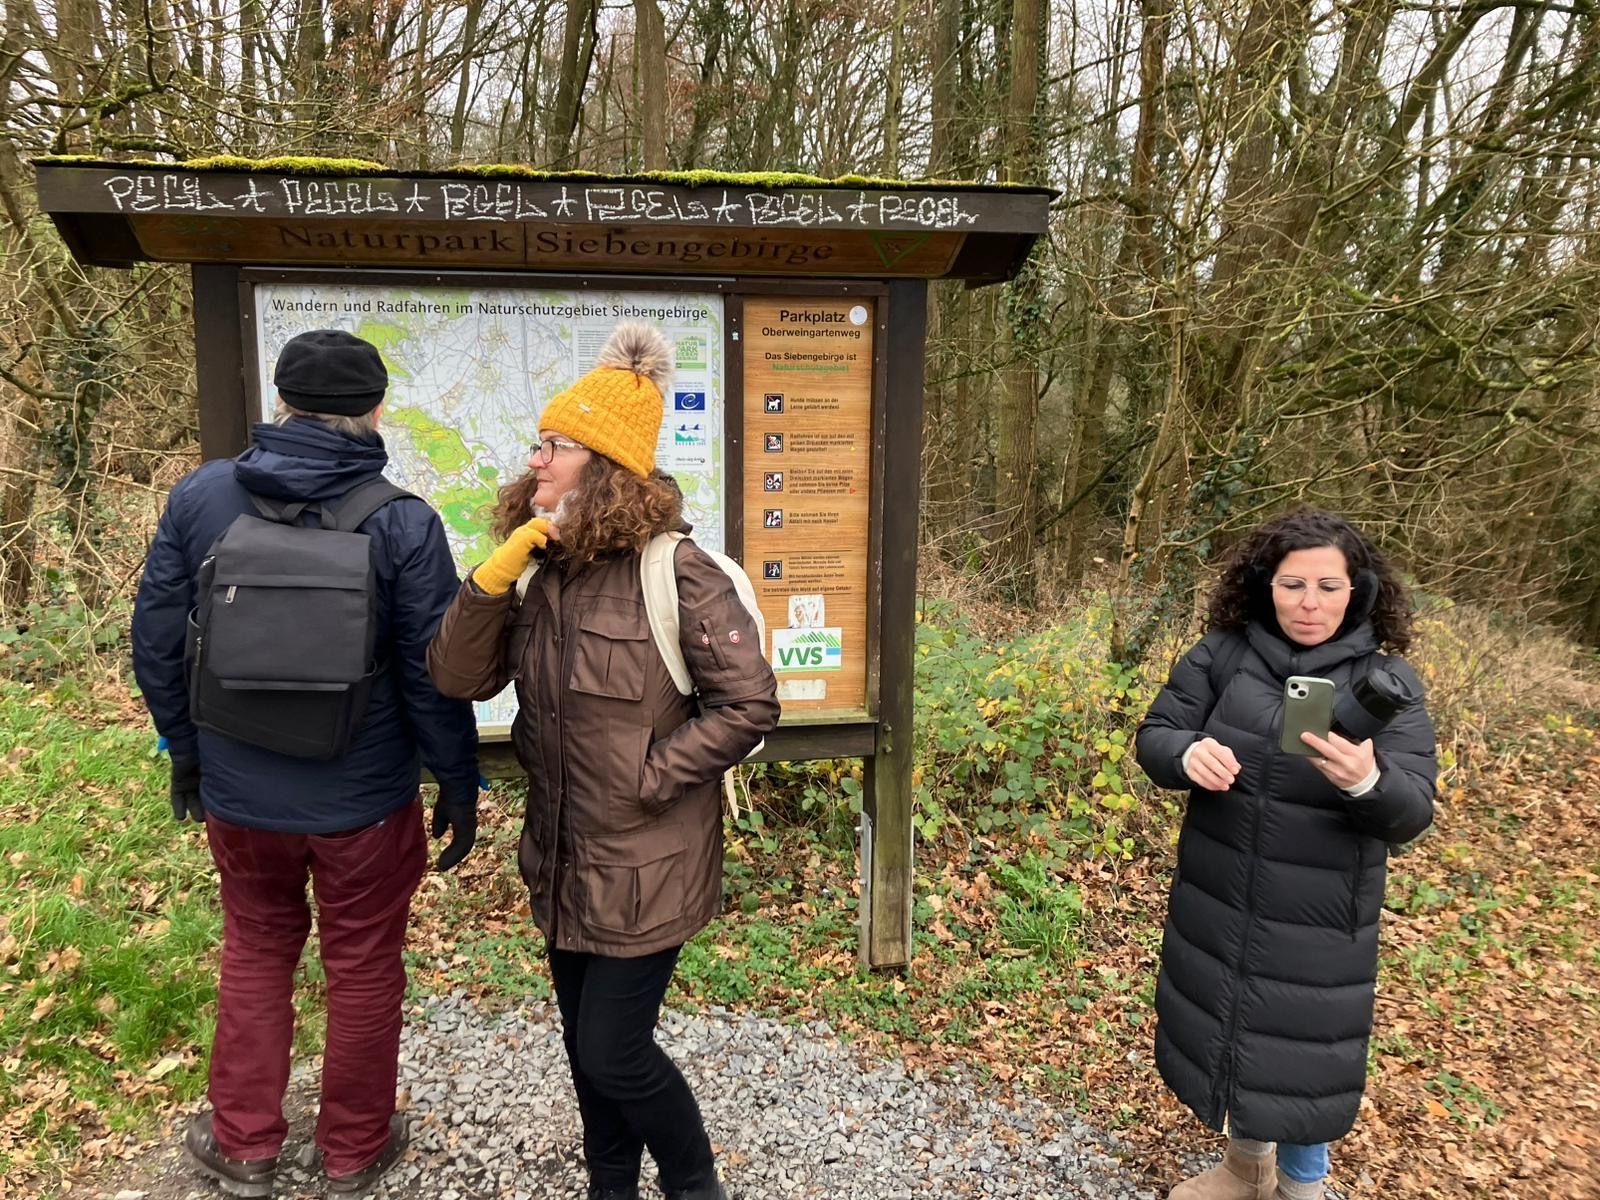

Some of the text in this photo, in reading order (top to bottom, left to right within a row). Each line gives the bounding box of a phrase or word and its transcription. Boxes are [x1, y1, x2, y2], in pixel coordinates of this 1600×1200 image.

[278, 225, 833, 266] Naturpark Siebengebirge
[272, 298, 708, 321] Wandern und Radfahren im Naturschutzgebiet Siebengebirge
[780, 310, 846, 325] Parkplatz
[762, 327, 861, 339] Oberweingartenweg
[765, 352, 857, 362] Das Siebengebirge ist
[778, 646, 823, 666] VVS
